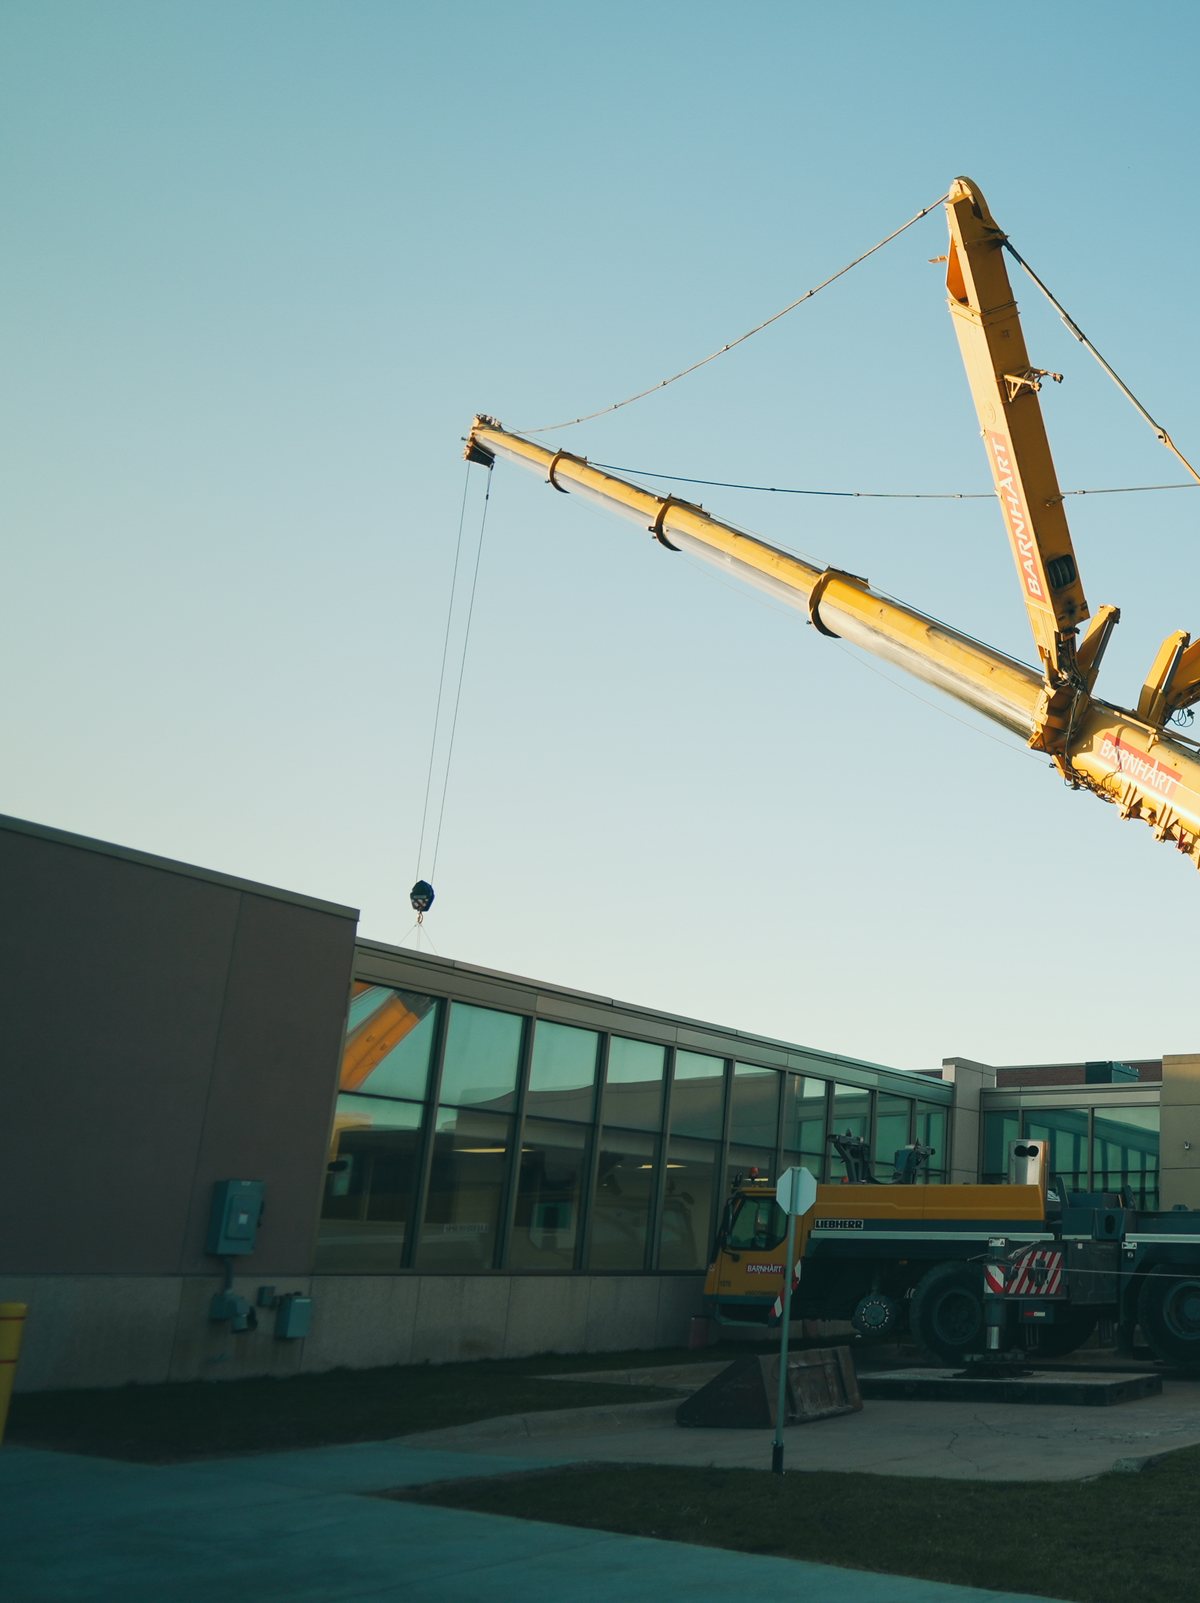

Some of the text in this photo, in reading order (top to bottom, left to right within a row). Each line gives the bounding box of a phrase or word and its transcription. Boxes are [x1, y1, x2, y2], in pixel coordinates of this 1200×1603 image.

[992, 437, 1042, 597] BARNHART
[1100, 738, 1178, 795] BARNHART
[815, 1220, 863, 1229] LIEBHERR
[747, 1264, 782, 1274] BARNHART
